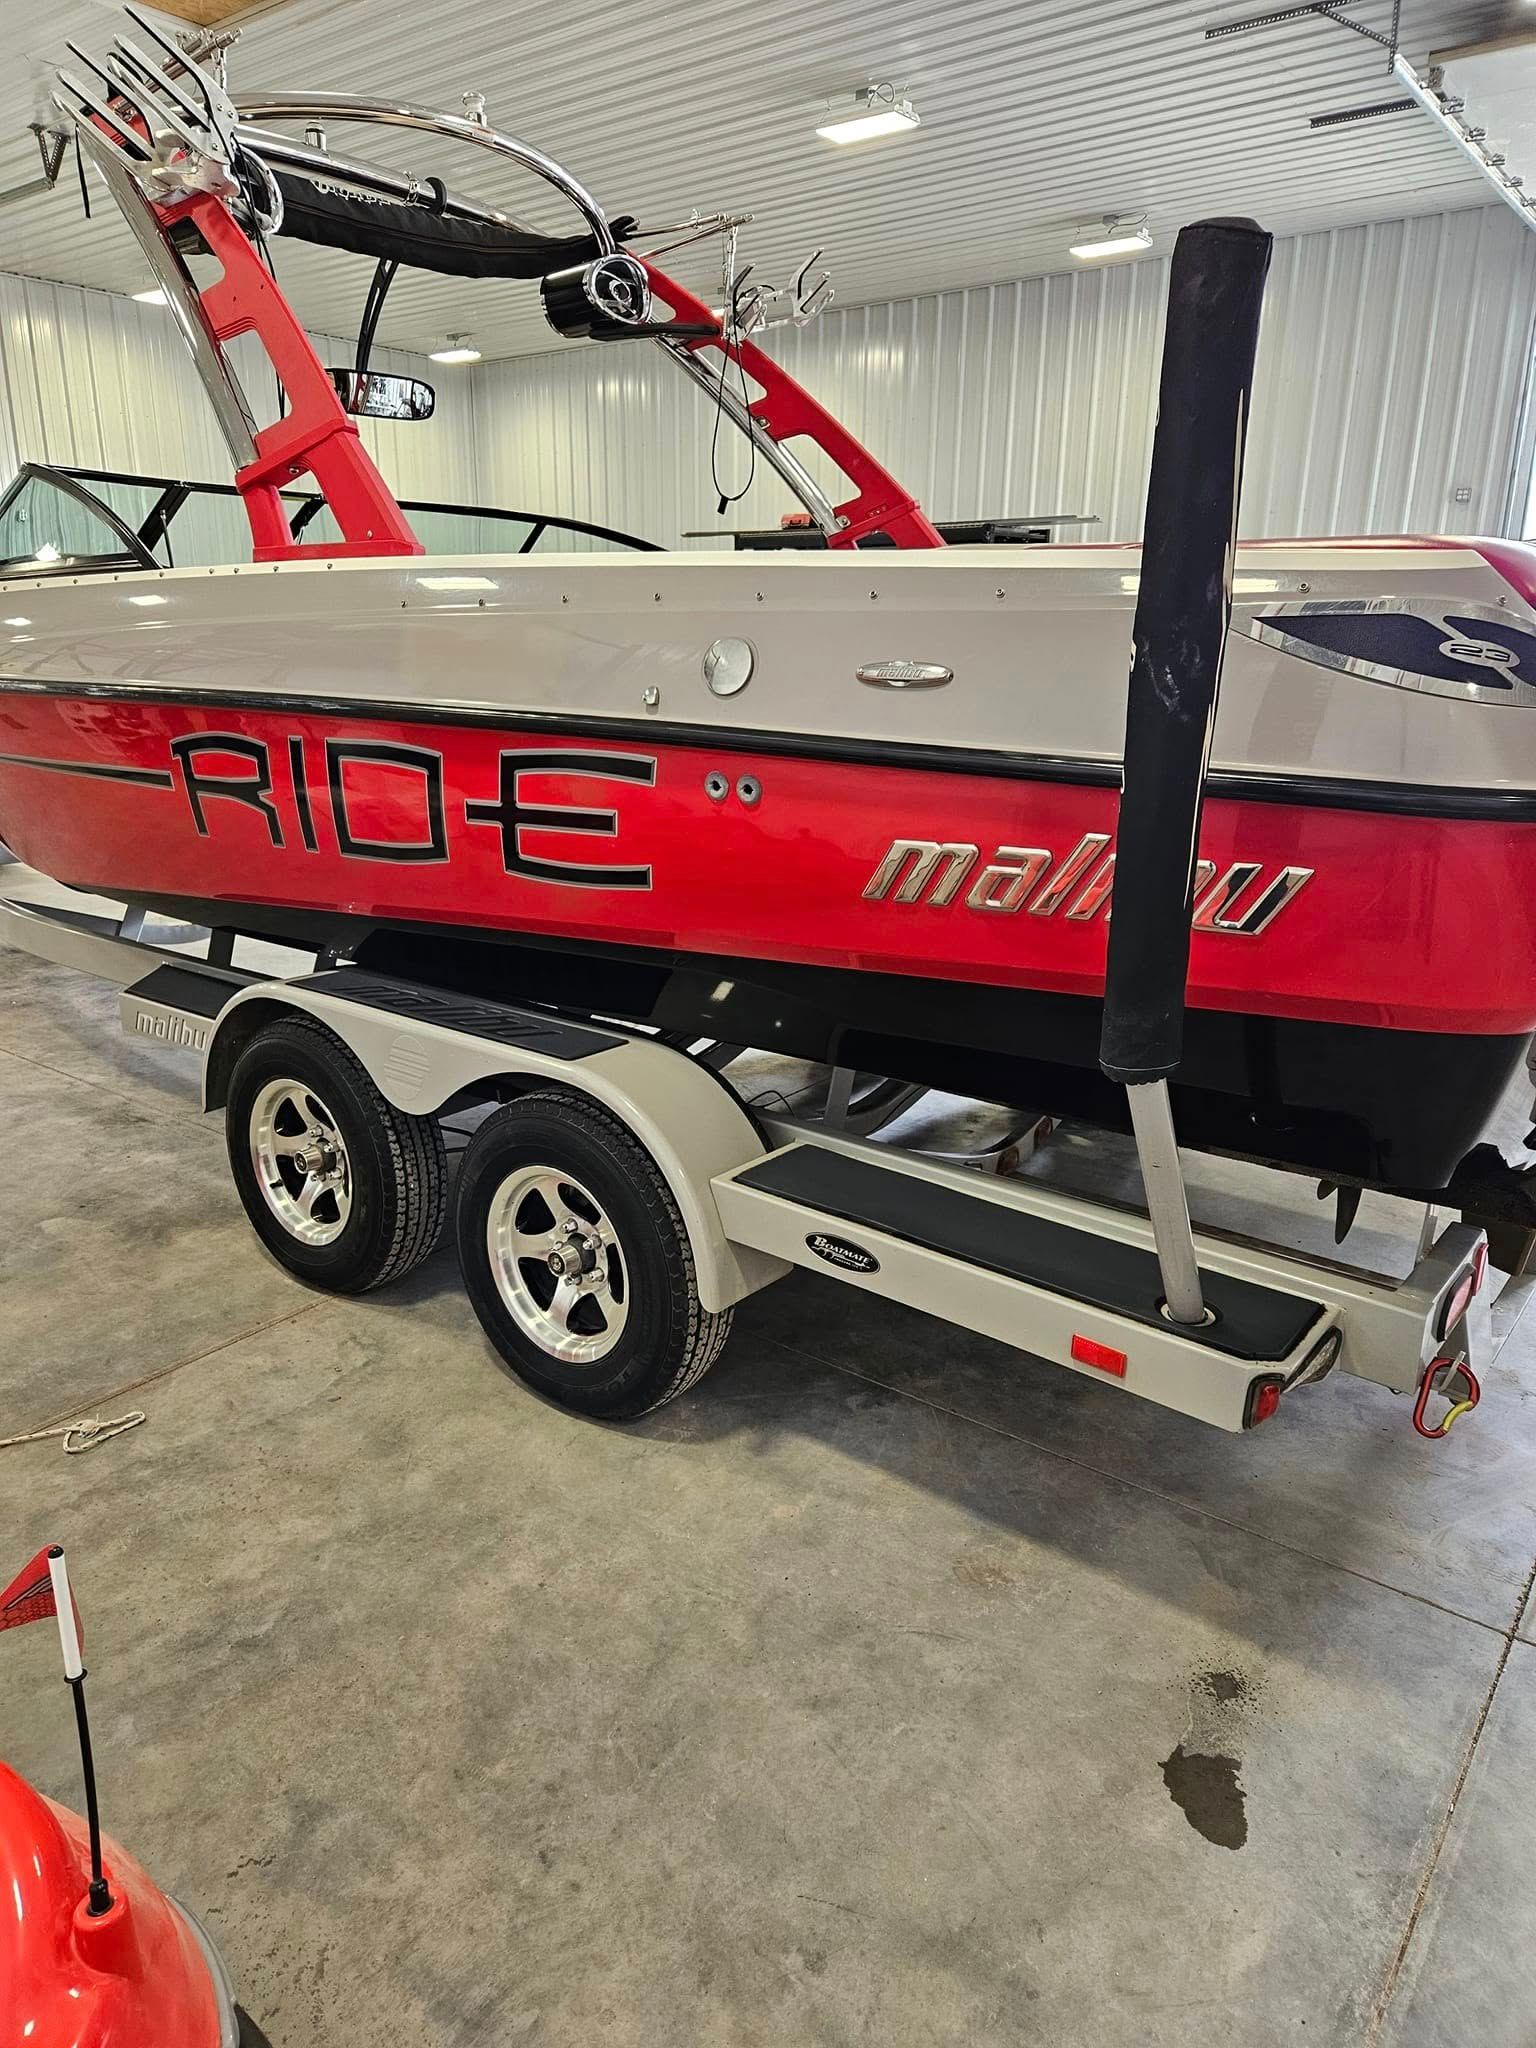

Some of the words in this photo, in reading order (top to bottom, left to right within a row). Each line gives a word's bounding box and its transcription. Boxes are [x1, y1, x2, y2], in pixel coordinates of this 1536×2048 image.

[1449, 643, 1511, 662] 23
[170, 731, 657, 890] RIDE
[862, 832, 1315, 936] maliu
[135, 1011, 208, 1051] malibu
